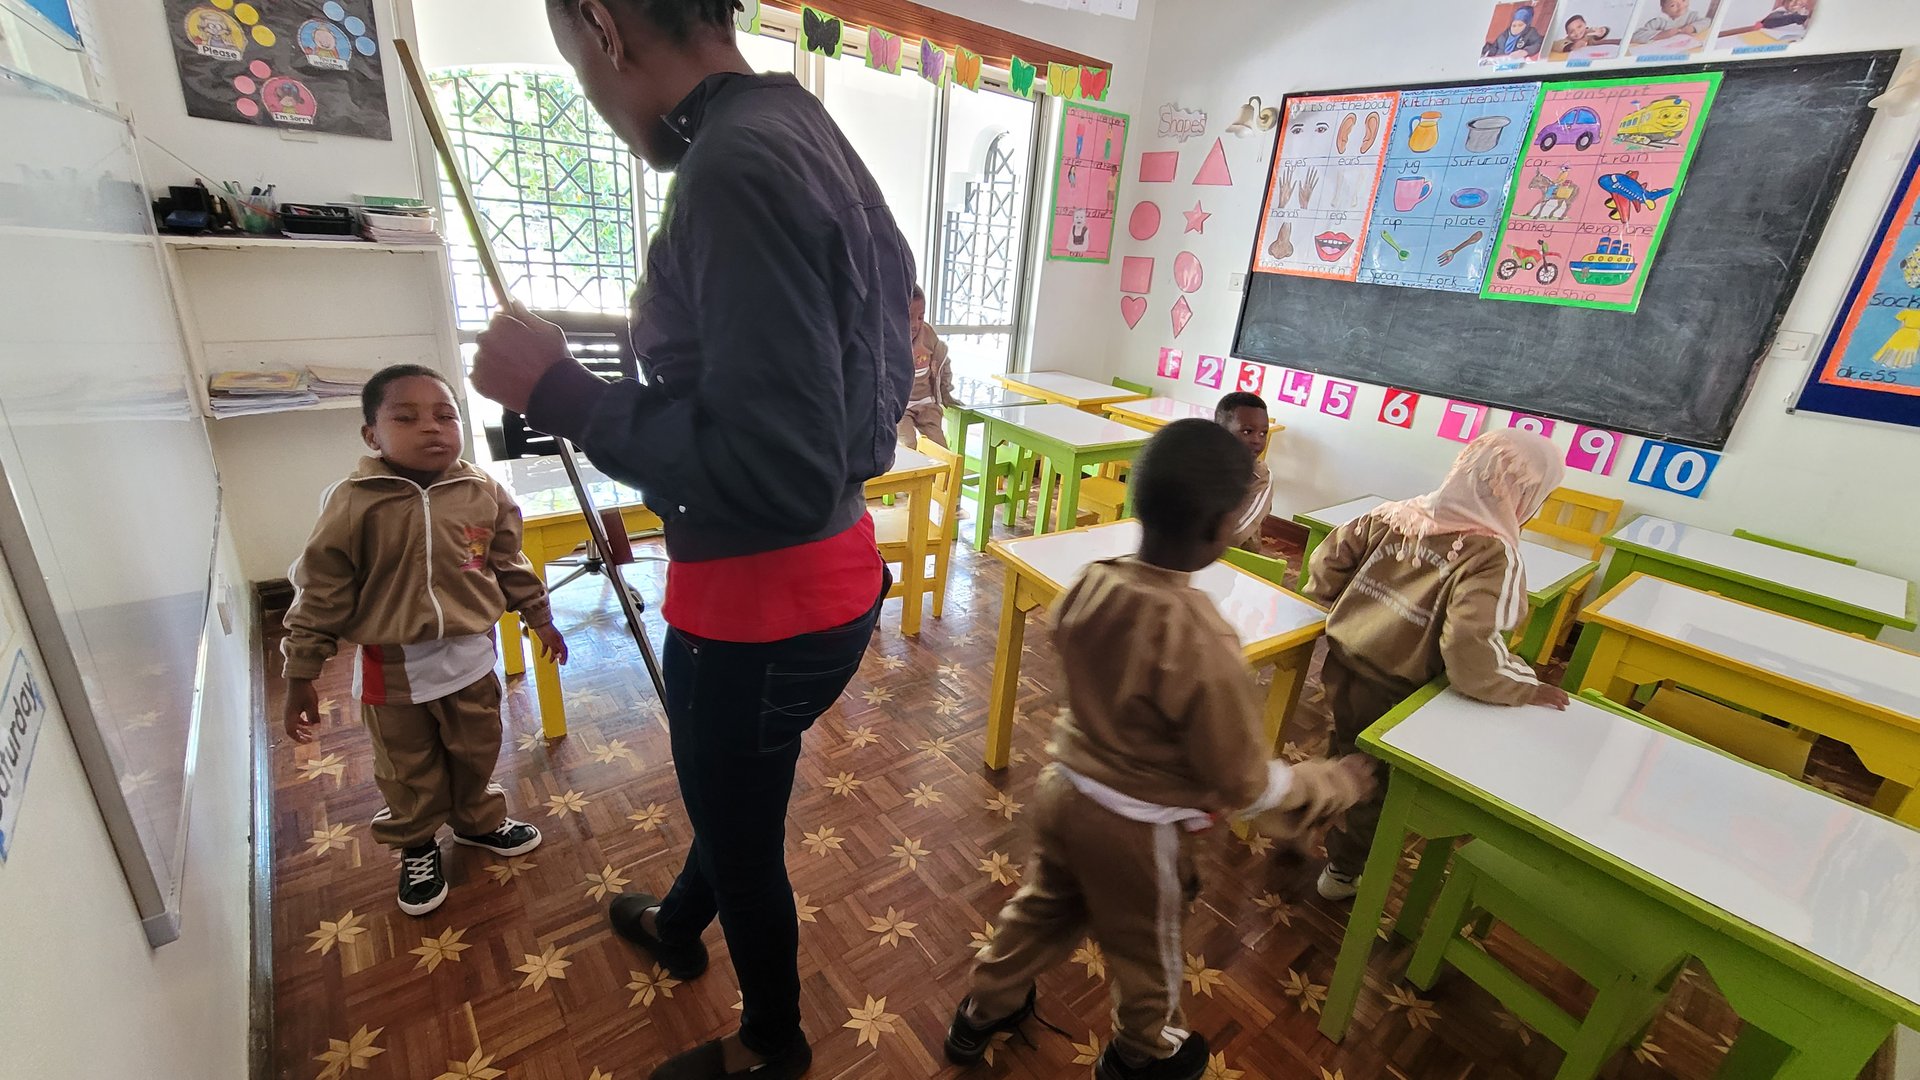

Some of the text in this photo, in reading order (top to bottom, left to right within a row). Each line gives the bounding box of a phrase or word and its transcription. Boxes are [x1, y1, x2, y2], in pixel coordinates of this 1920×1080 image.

[202, 45, 238, 59] Please
[1326, 102, 1336, 111] of
[1341, 101, 1361, 110] the
[1362, 99, 1392, 115] body
[289, 115, 313, 124] Sorry
[1159, 109, 1206, 141] Shapes
[1285, 158, 1308, 172] eyes
[1338, 155, 1361, 166] ears
[1525, 158, 1551, 167] car
[1600, 153, 1648, 164] train
[1400, 159, 1421, 174] jug
[1271, 209, 1299, 218] hands
[1326, 210, 1347, 225] legs
[1382, 217, 1402, 230] cup
[1444, 216, 1487, 228] plate
[1507, 221, 1554, 238] donkey
[1578, 223, 1653, 237] Aeropane
[1427, 274, 1457, 286] fork
[1488, 284, 1558, 297] motorbike
[1837, 365, 1898, 383] dress
[1196, 358, 1218, 386] 2
[1240, 365, 1262, 392] 3
[1282, 373, 1308, 405] 4
[1326, 384, 1350, 415] 5
[1383, 393, 1409, 425] 6
[1450, 404, 1479, 440] 7
[1579, 429, 1614, 473] 9
[1637, 445, 1706, 491] 10
[0, 672, 37, 822] aturday
